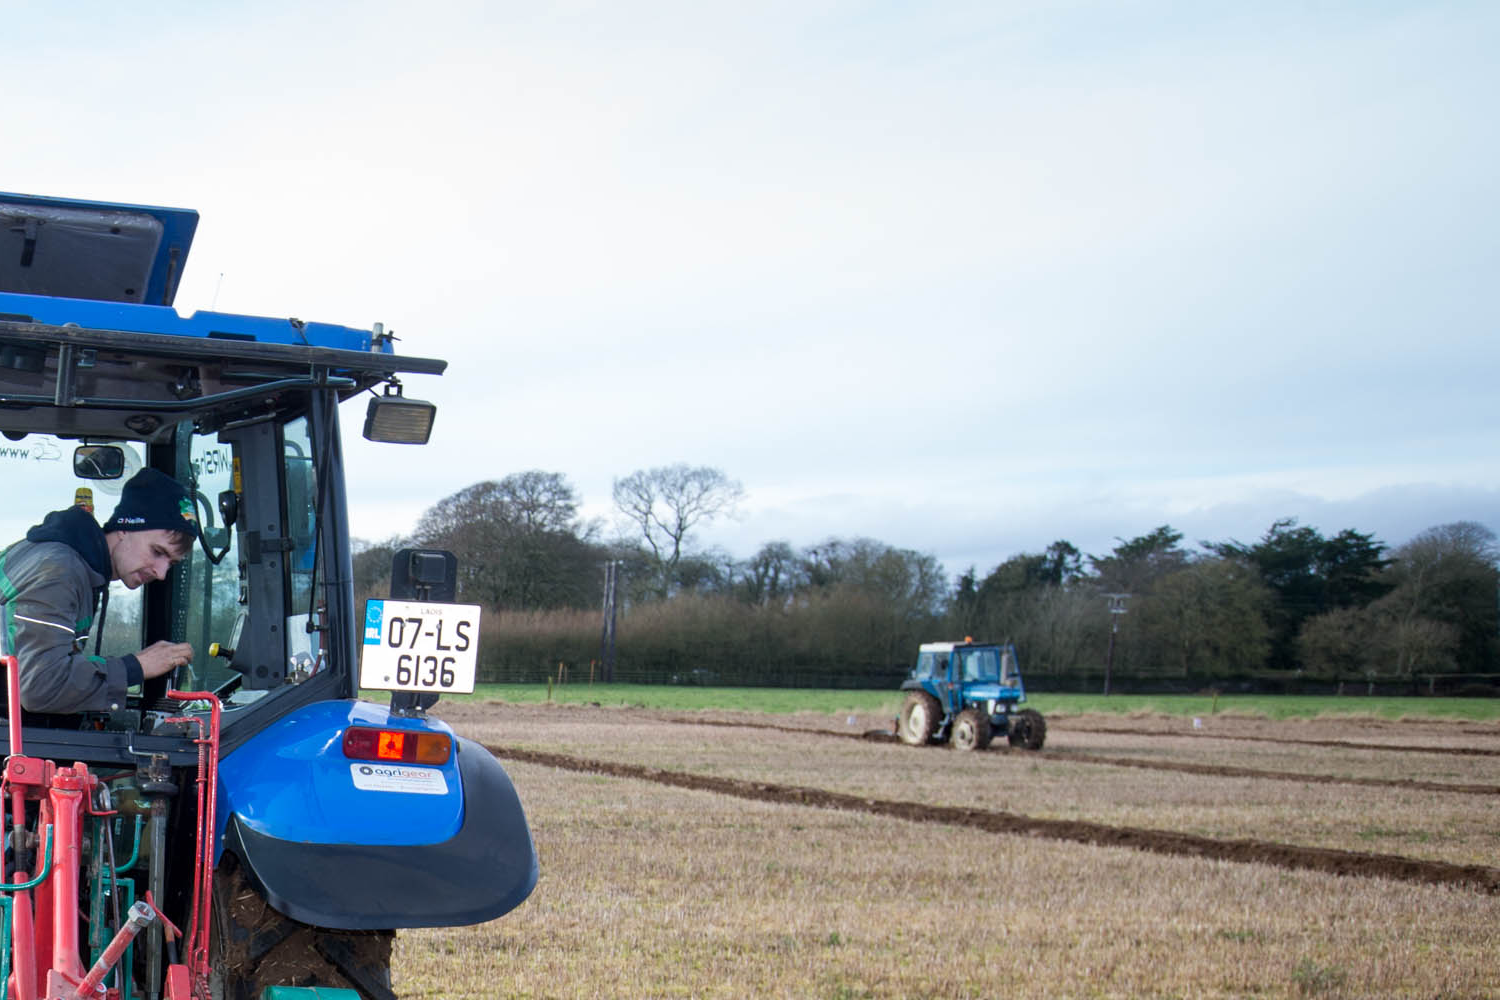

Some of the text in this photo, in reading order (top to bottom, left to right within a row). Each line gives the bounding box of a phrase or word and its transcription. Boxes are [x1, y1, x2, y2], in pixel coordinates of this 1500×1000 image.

[365, 627, 381, 639] IRL
[388, 616, 471, 652] 07-LS
[396, 654, 456, 688] 6136
[374, 767, 433, 779] agrigear
